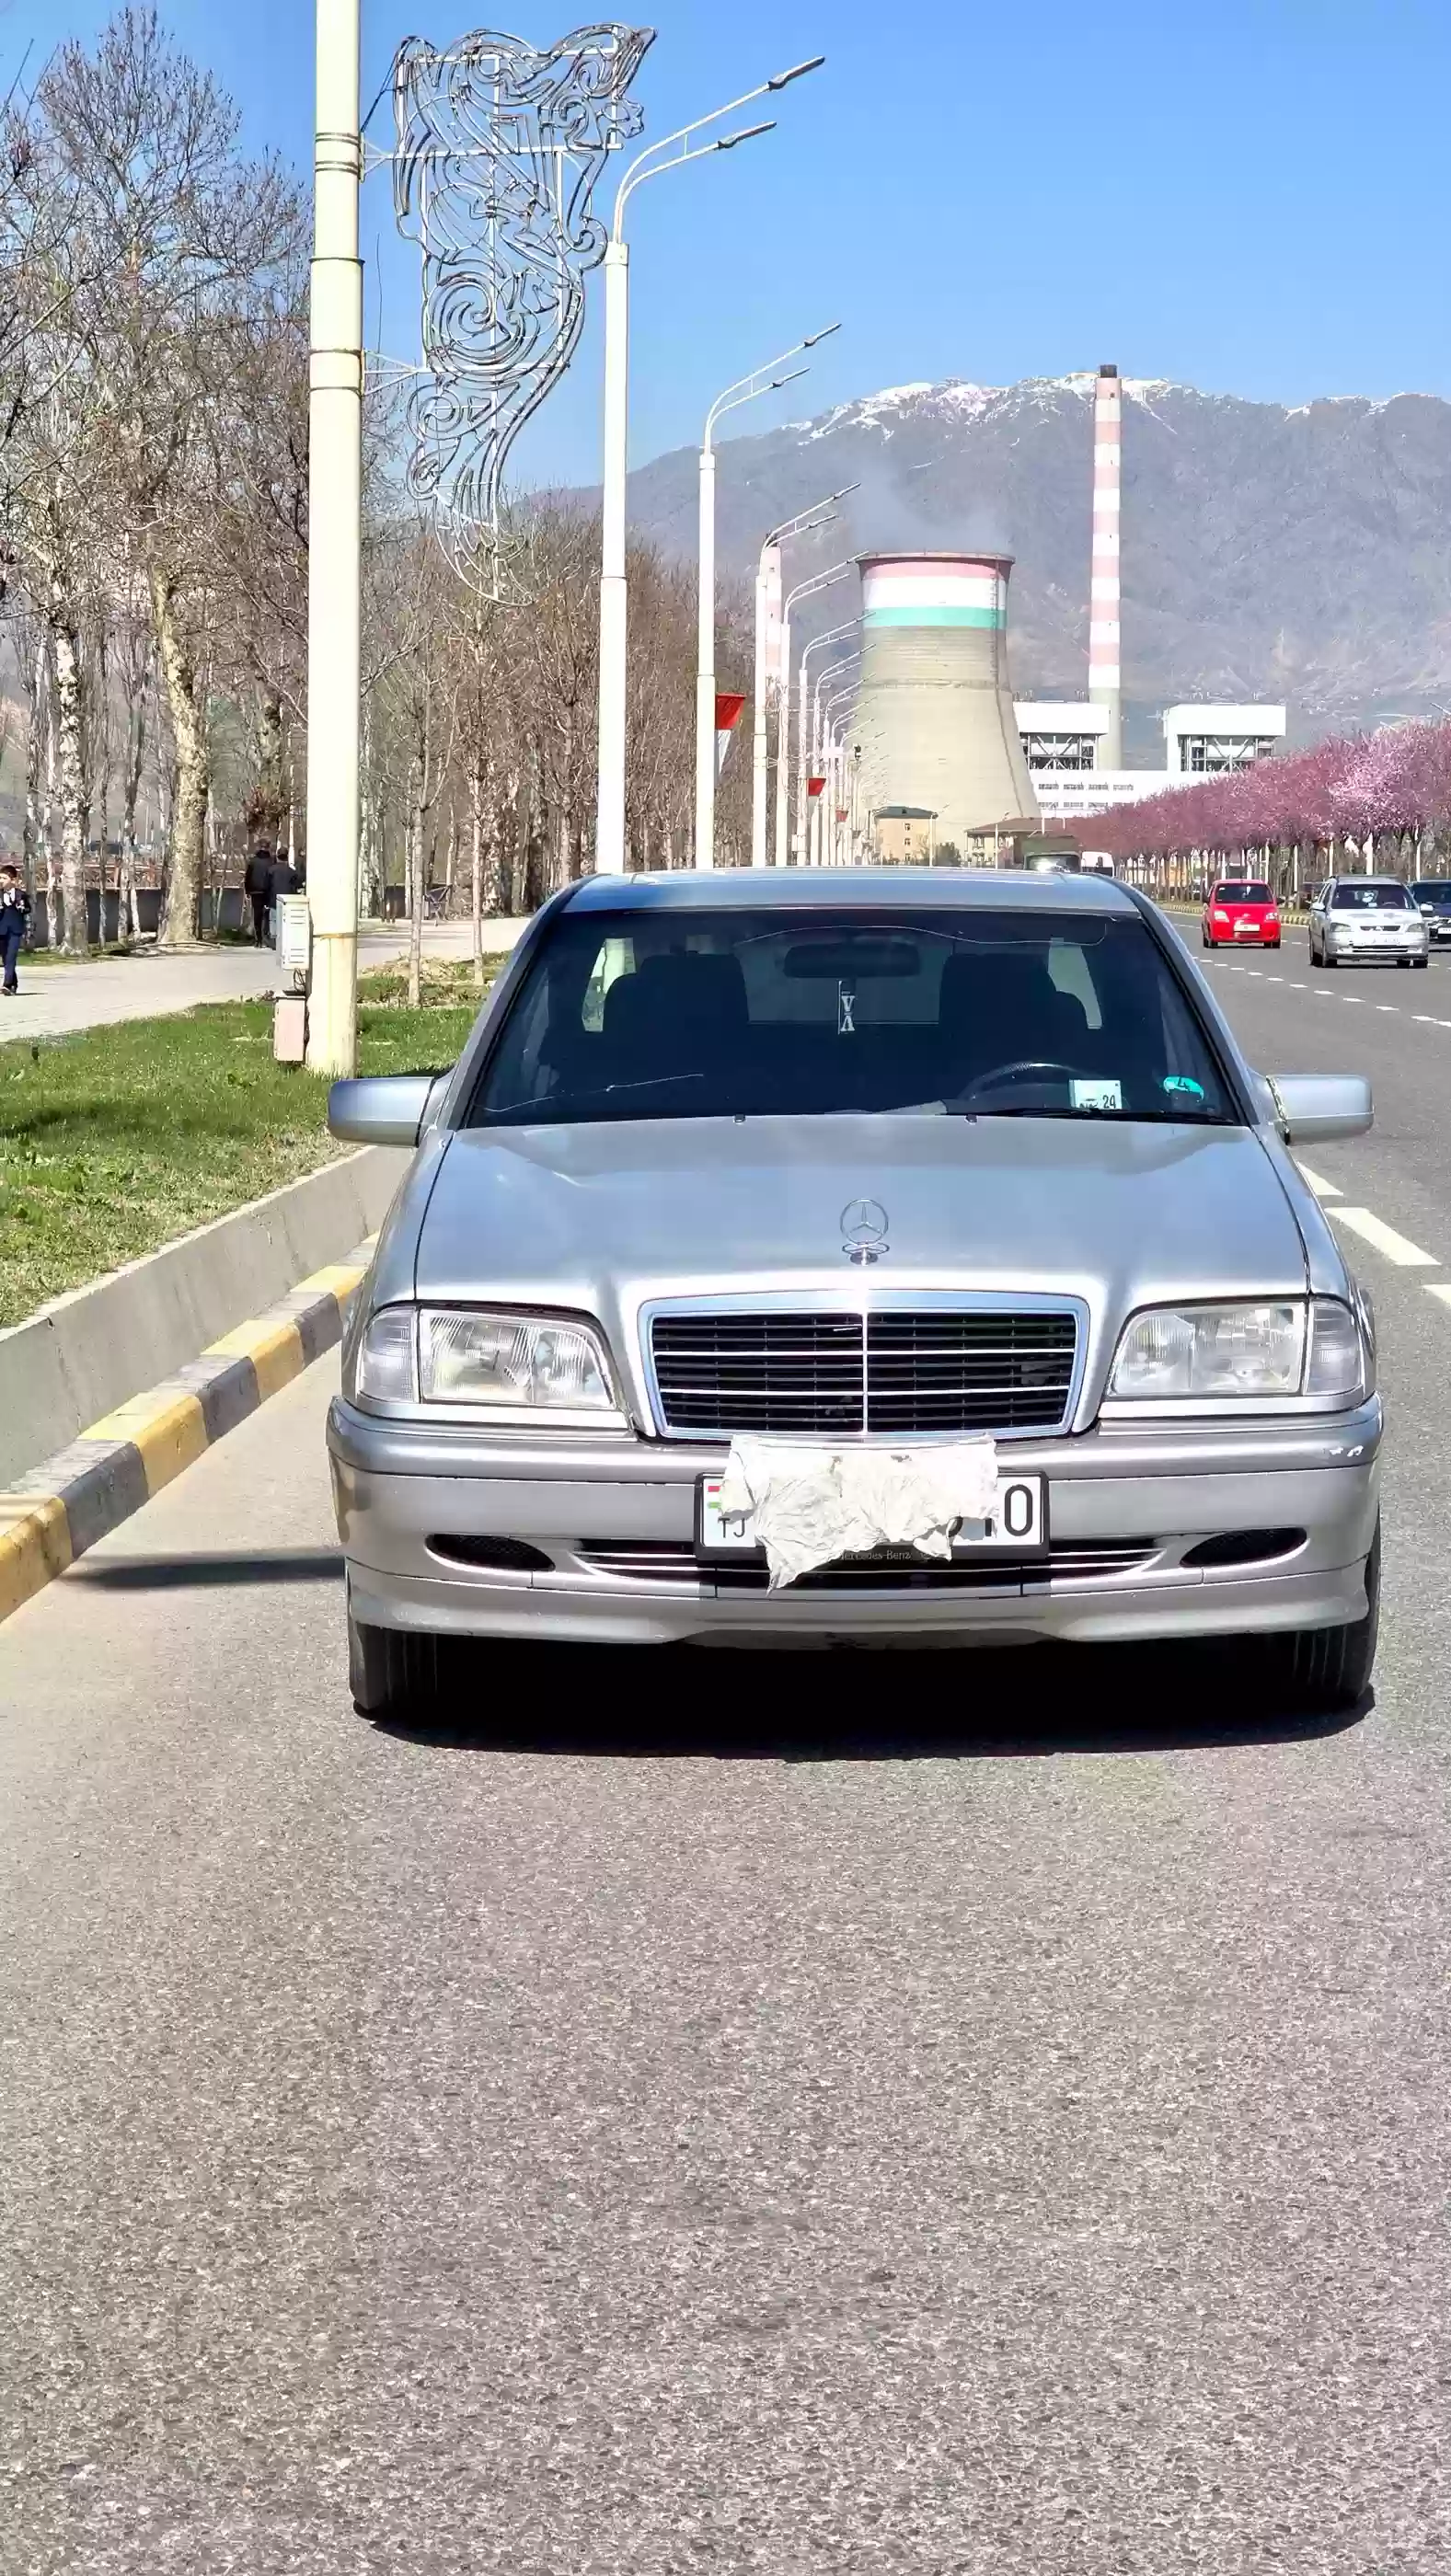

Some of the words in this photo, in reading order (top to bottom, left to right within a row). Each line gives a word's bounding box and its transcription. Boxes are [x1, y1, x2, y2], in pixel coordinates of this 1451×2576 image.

[1102, 1094, 1116, 1109] 24
[718, 1517, 744, 1538] TJ
[841, 1549, 912, 1561] ercedes-Benz
